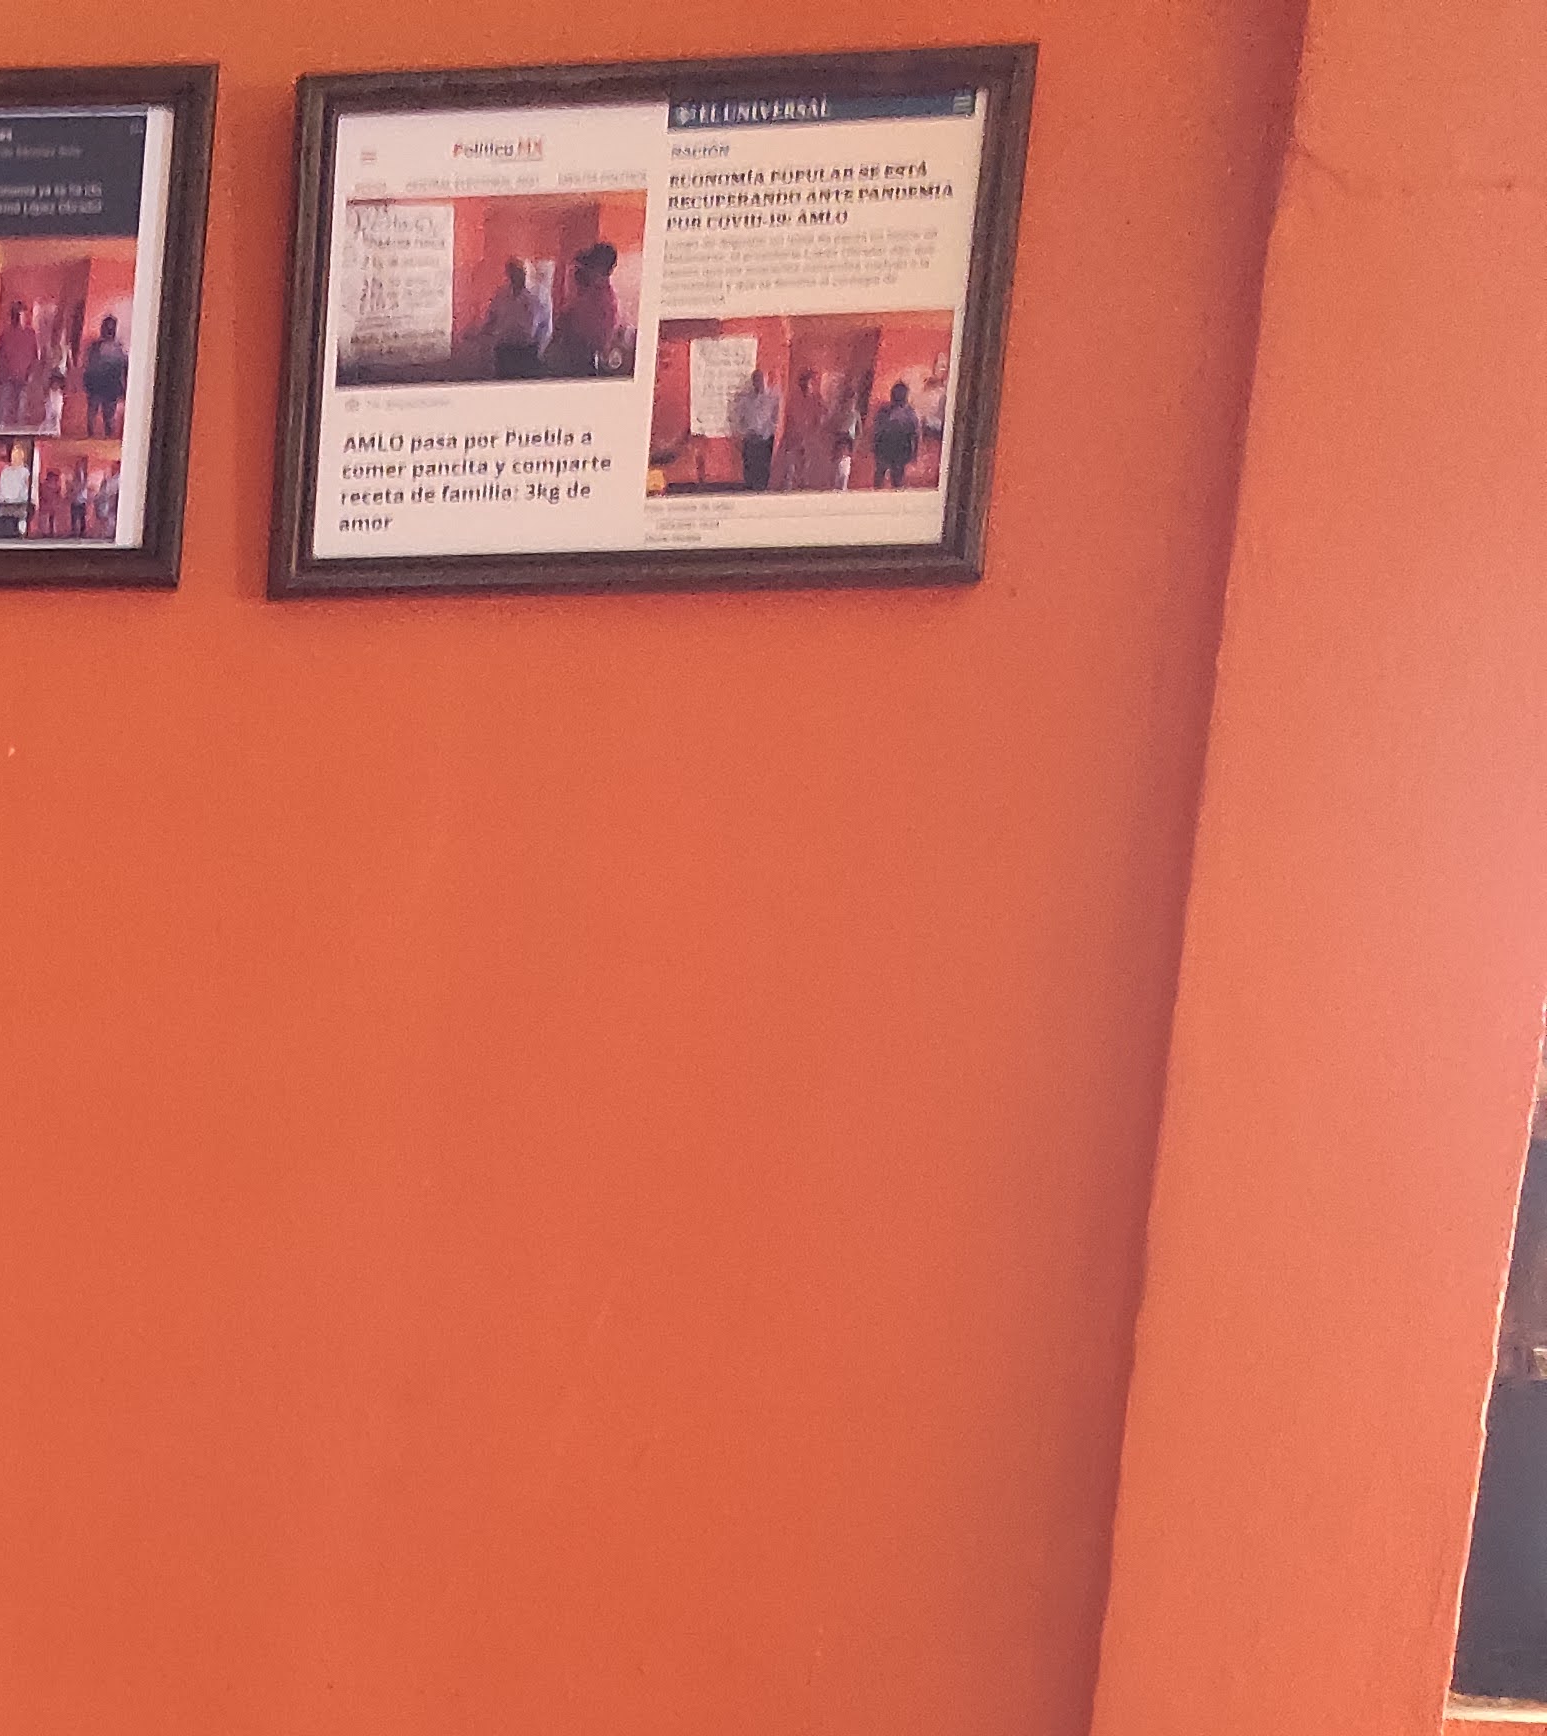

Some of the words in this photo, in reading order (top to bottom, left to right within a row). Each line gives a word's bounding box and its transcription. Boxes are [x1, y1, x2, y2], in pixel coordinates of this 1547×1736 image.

[669, 167, 766, 189] ECONOMÍA
[770, 166, 854, 186] POPULAR
[667, 191, 802, 210] RECUPERANDO
[806, 188, 854, 205] ANTE
[857, 183, 955, 202] PANDEMIA
[666, 214, 702, 232] POR
[797, 207, 849, 226] AMLO
[343, 433, 405, 455] AMLO
[410, 434, 458, 454] pasa
[463, 433, 499, 454] por
[505, 428, 575, 449] Puebla
[580, 431, 593, 446] a
[341, 462, 407, 481] comer
[495, 460, 506, 479] y
[511, 454, 613, 477] comparte
[339, 487, 405, 506] receta
[410, 486, 436, 504] de
[525, 482, 561, 506] 3kg
[566, 479, 592, 500] de
[338, 514, 394, 533] amor
